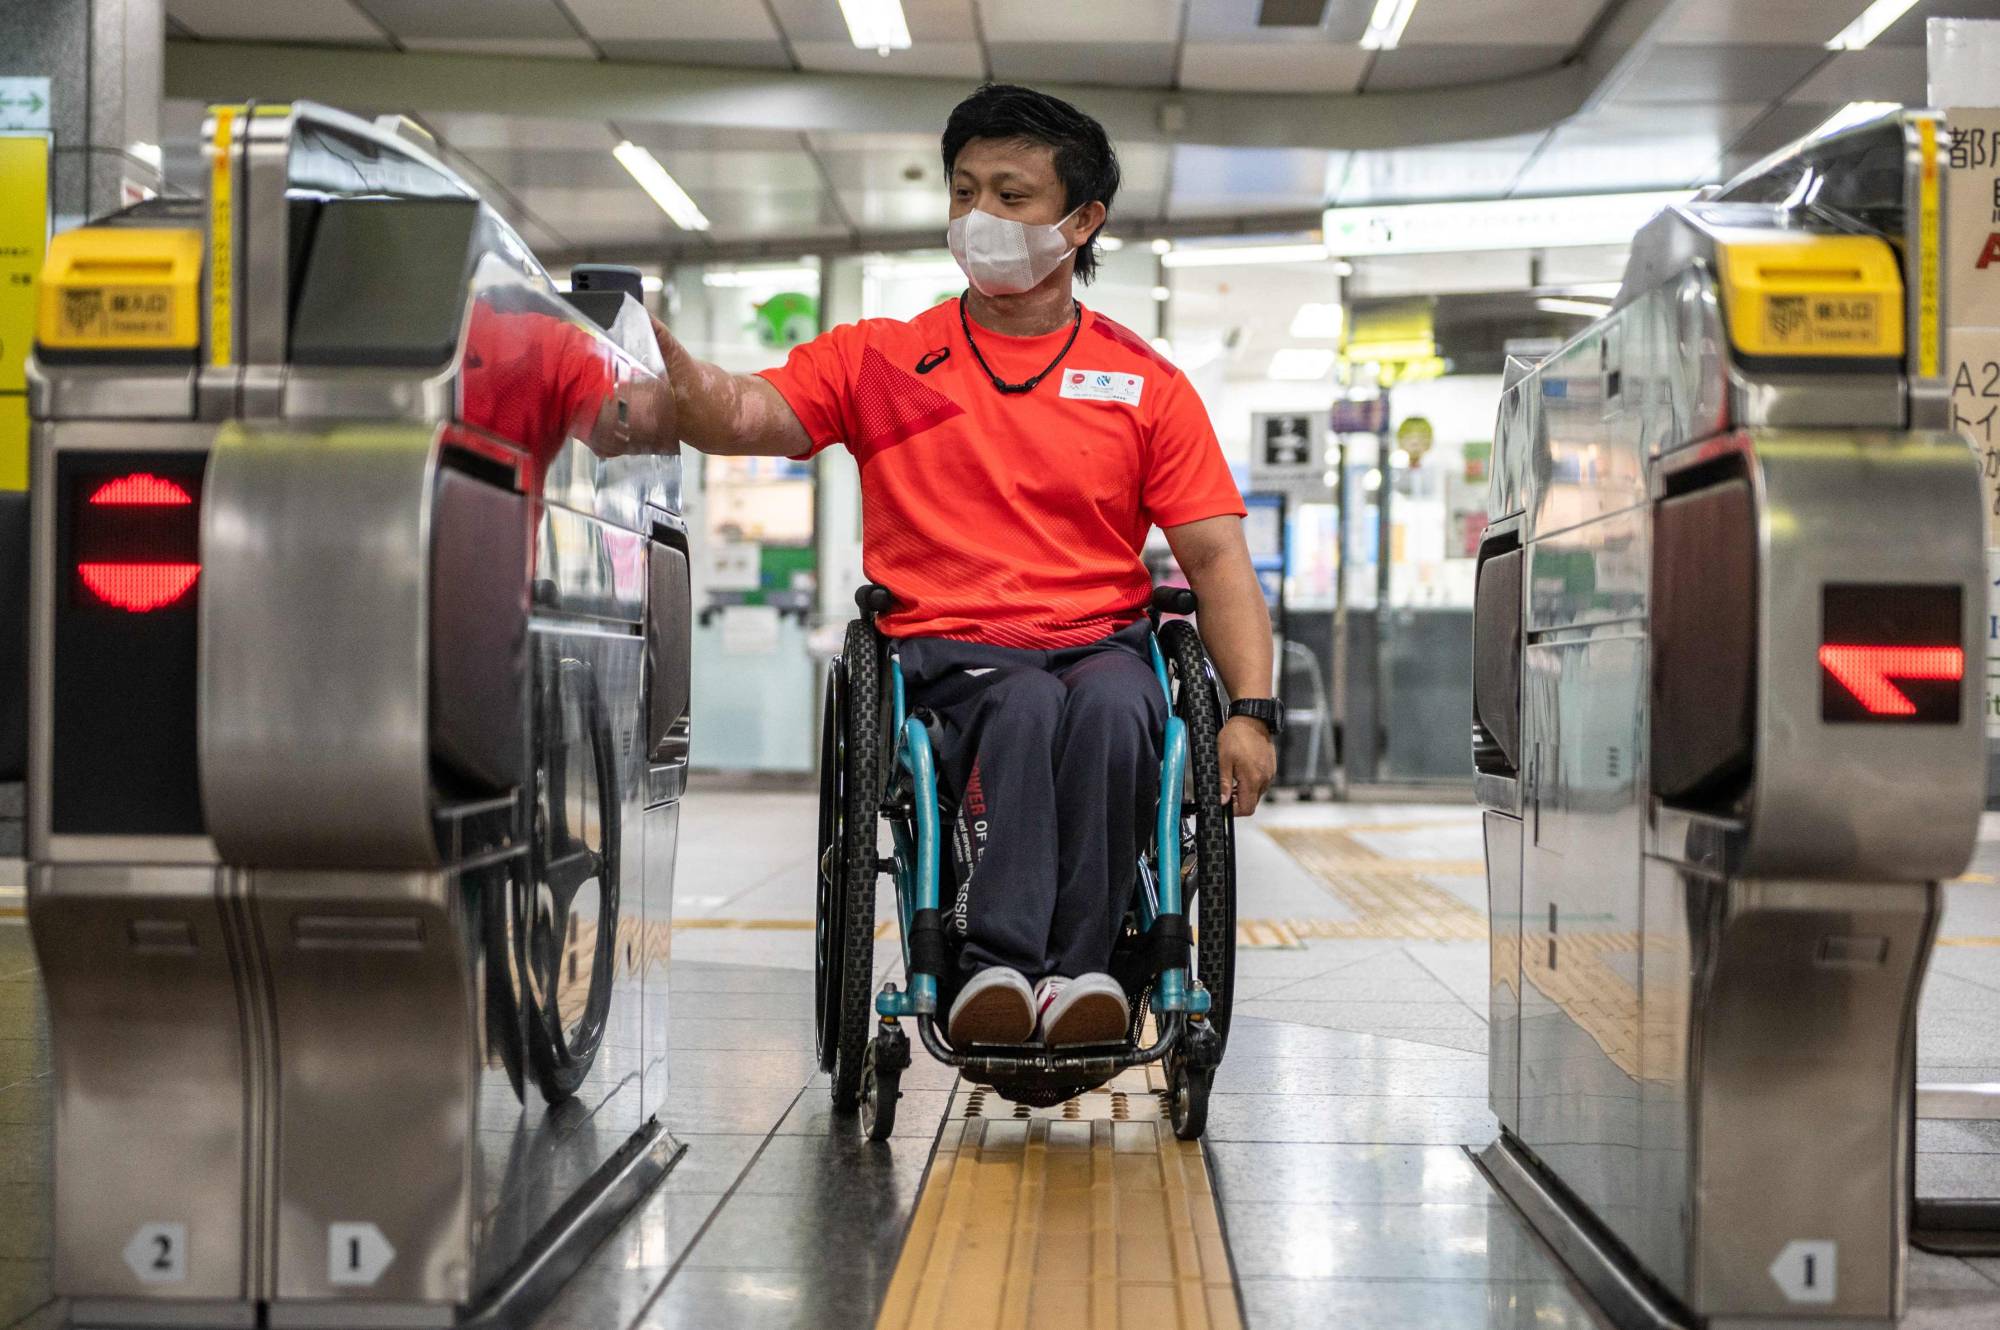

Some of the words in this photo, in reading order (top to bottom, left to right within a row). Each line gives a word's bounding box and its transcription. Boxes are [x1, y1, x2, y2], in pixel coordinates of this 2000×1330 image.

[974, 820, 988, 842] OF
[153, 1234, 173, 1271] 2
[349, 1236, 361, 1271] 1
[1804, 1253, 1816, 1288] 1
